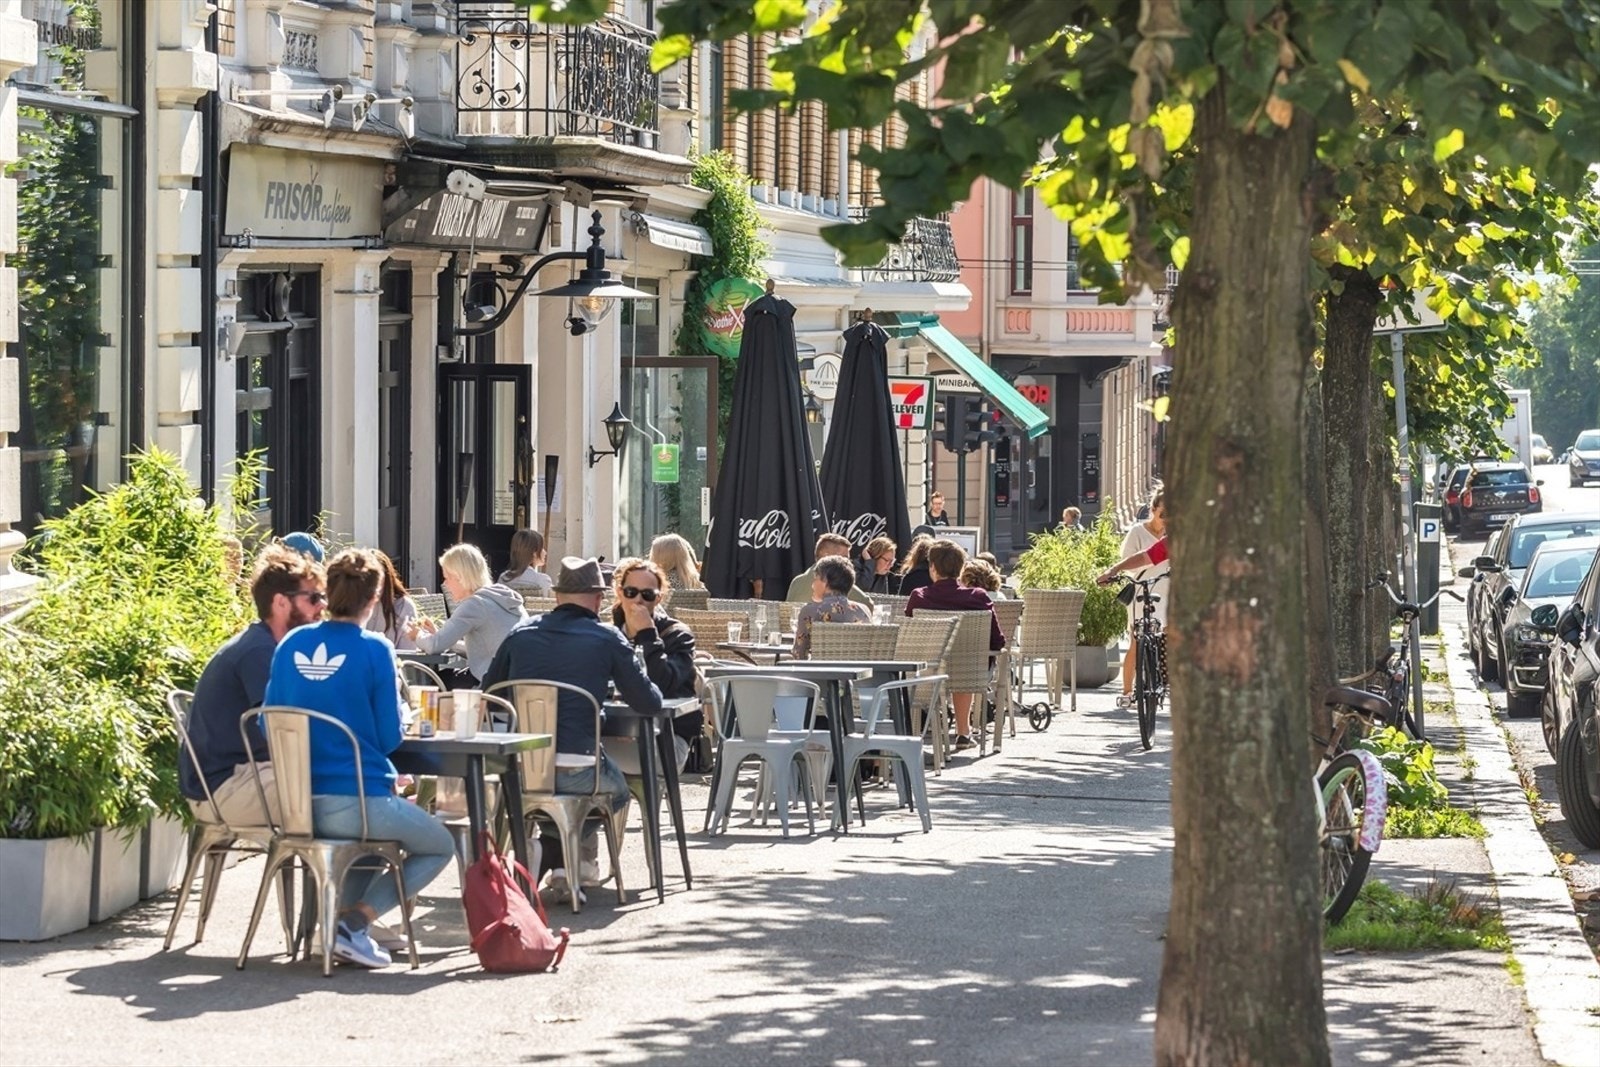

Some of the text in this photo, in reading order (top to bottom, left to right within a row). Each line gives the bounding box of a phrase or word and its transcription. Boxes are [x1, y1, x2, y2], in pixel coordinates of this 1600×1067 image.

[264, 181, 323, 221] FRISØR
[891, 383, 924, 428] 7
[1424, 522, 1437, 538] P
